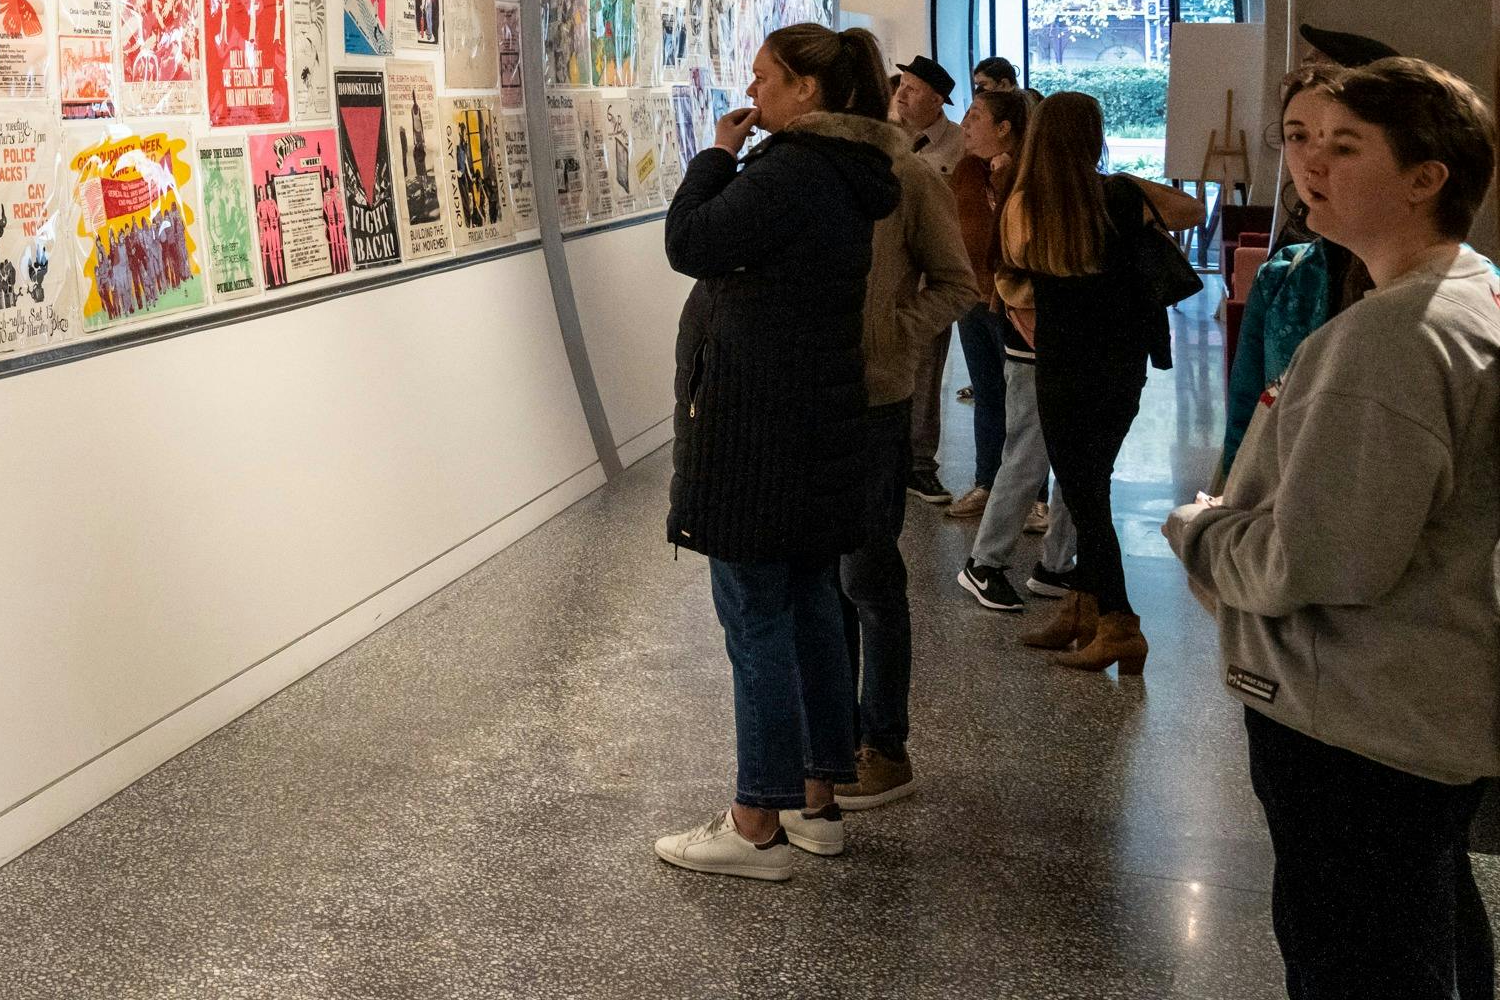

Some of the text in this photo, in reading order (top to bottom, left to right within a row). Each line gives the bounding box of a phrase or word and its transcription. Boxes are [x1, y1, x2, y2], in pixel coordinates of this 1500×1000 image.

[338, 81, 382, 96] HOMOSEXUALS
[3, 147, 36, 164] POLICE
[28, 184, 46, 199] GAY
[353, 204, 389, 234] FIGHT
[354, 232, 396, 262] BACK!
